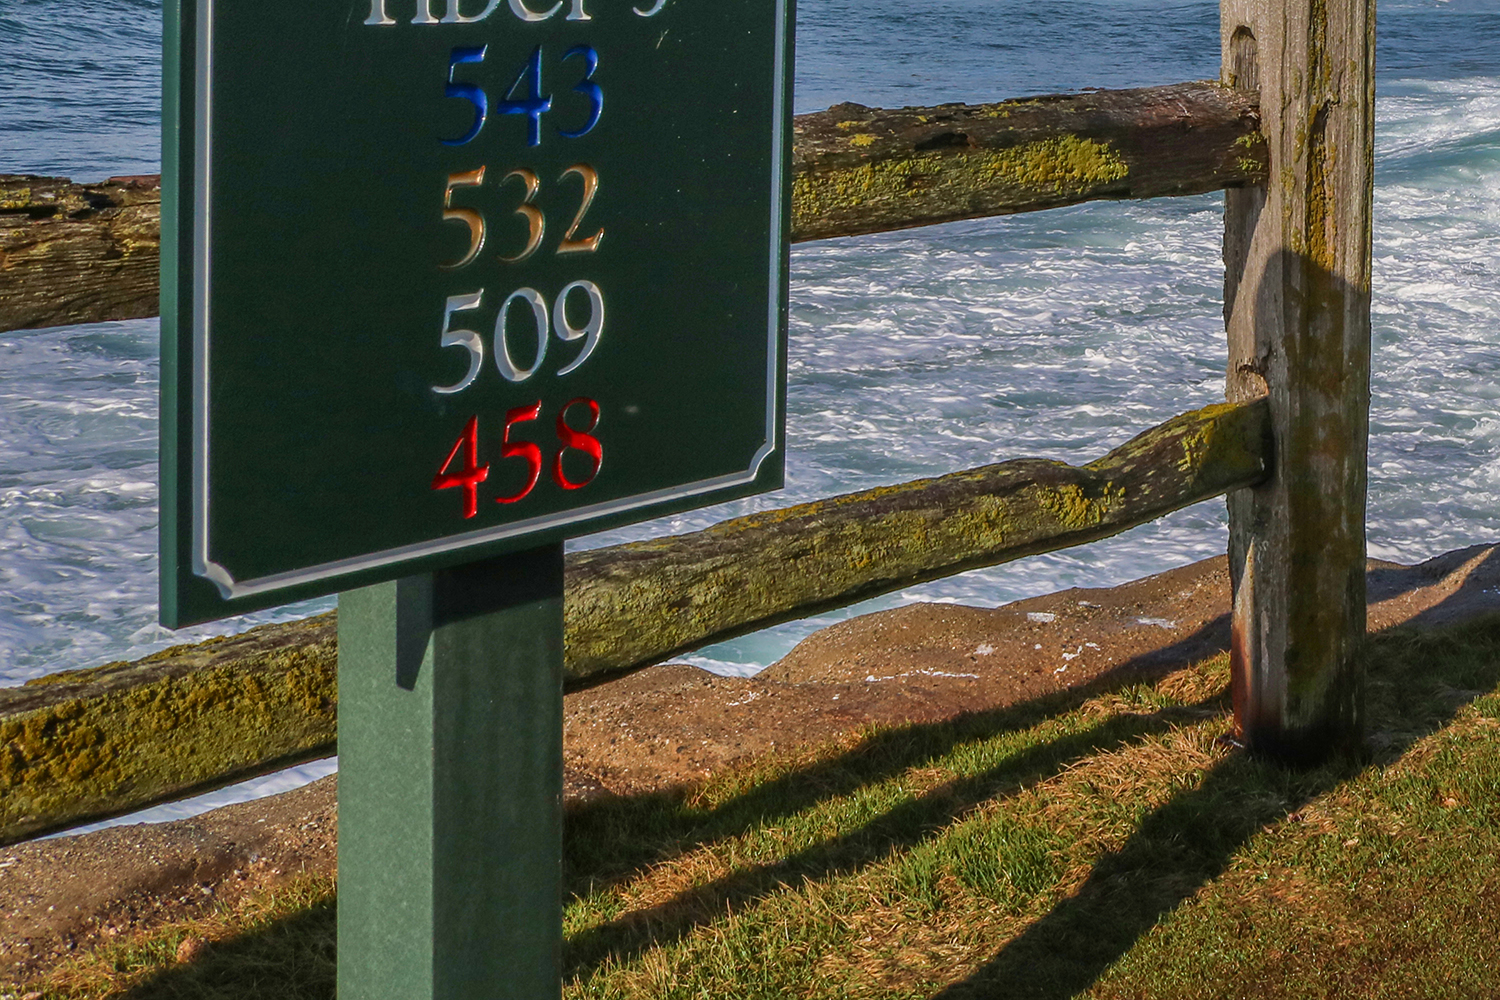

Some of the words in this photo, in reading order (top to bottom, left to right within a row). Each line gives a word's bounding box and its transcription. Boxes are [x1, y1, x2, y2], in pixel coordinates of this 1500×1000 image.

[439, 43, 604, 147] 543
[439, 163, 605, 269] 532
[432, 279, 605, 395] 509
[431, 398, 603, 520] 458
